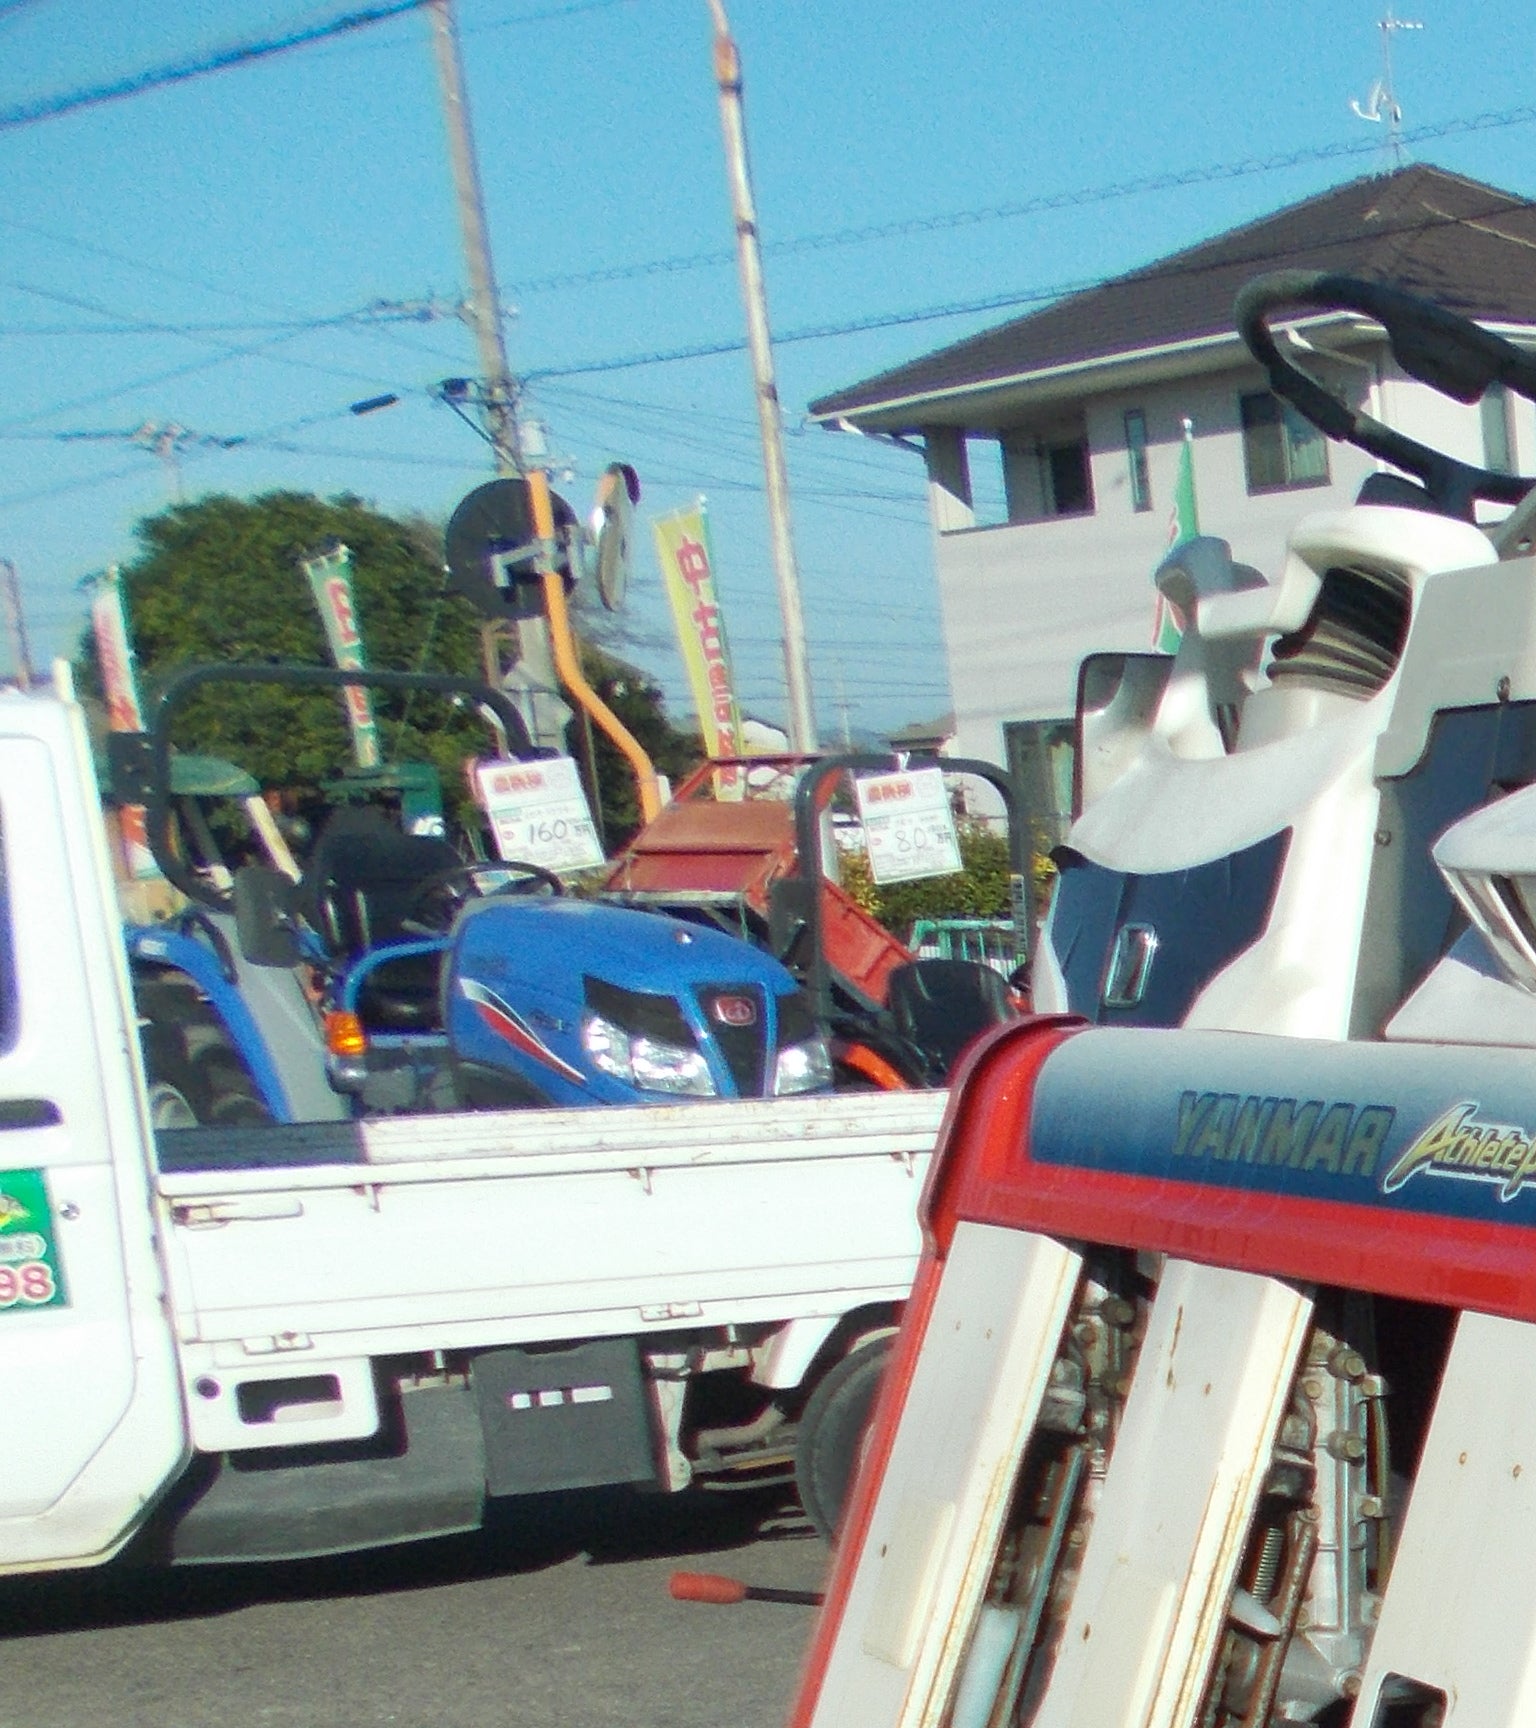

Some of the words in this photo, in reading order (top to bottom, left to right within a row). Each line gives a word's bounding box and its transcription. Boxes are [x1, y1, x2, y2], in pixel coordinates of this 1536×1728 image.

[529, 819, 567, 844] 160
[896, 827, 926, 852] 80
[1173, 1090, 1396, 1176] YANMAR
